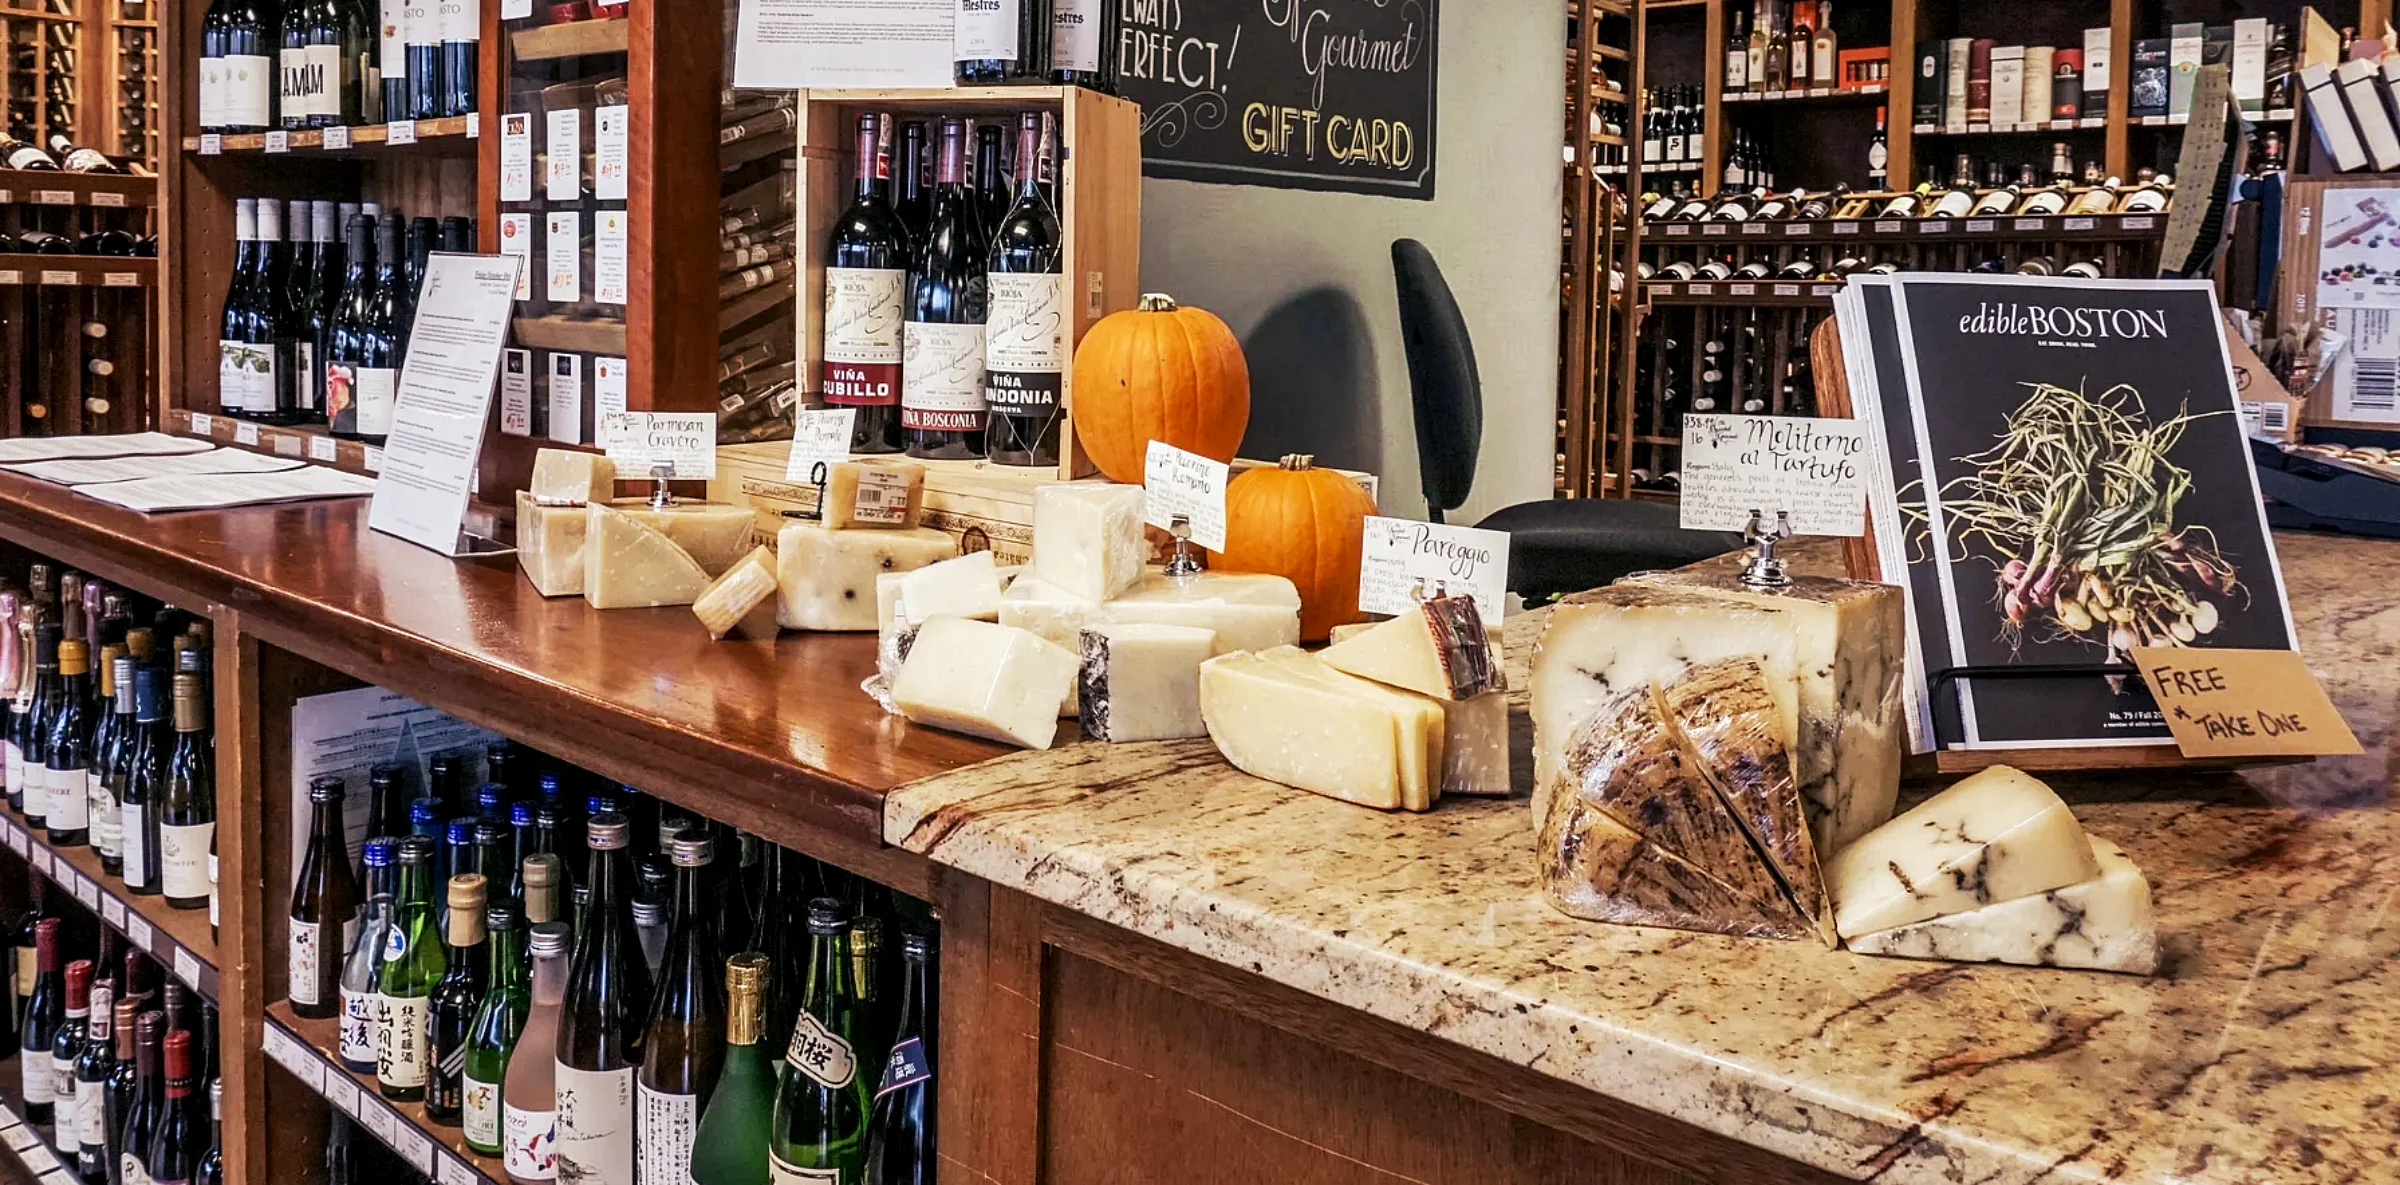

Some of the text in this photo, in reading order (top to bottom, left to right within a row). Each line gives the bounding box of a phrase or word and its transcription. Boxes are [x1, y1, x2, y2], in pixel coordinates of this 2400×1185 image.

[1119, 24, 1242, 94] ERFECT!
[1302, 9, 1422, 110] Gourmet
[1242, 102, 1414, 170] GIFT CARD
[833, 369, 865, 381] VIÑA
[992, 373, 1022, 388] VIÑA
[646, 413, 705, 433] Parmesan
[922, 412, 977, 428] BOSCONIA
[647, 431, 700, 450] Cravero
[1744, 418, 1864, 457] Moliterno
[1740, 450, 1857, 484] al Tartufo
[2151, 665, 2227, 698] FREE
[2193, 710, 2308, 741] TAKE ONE
